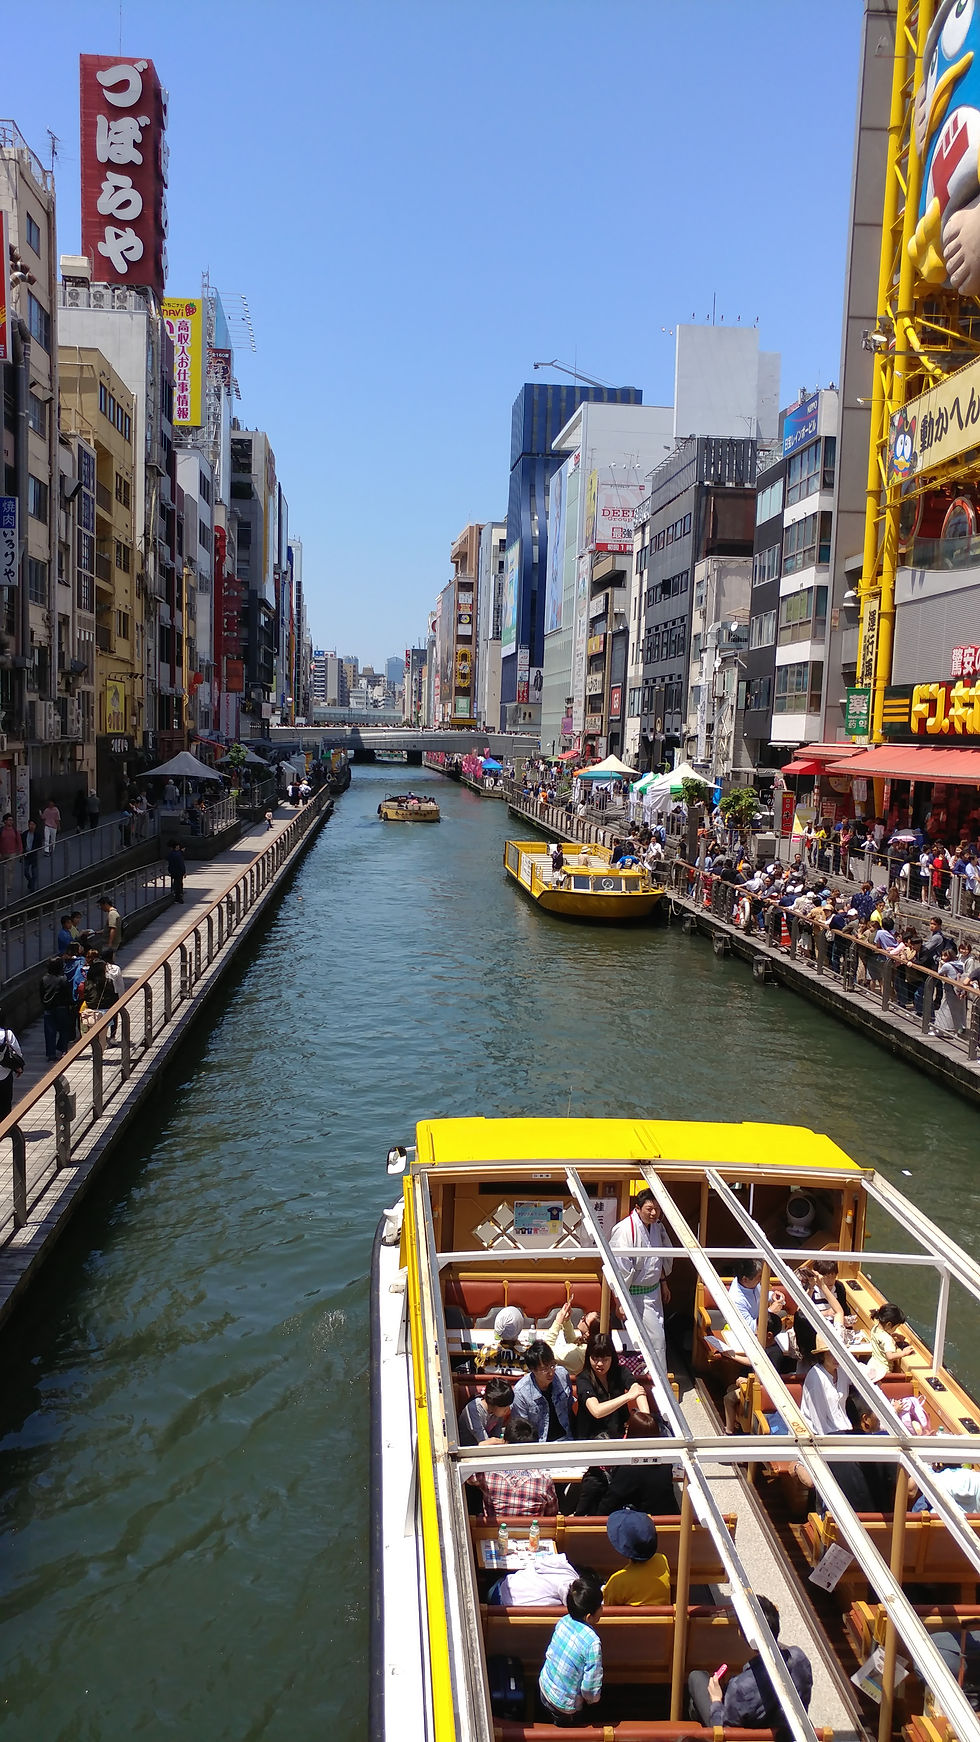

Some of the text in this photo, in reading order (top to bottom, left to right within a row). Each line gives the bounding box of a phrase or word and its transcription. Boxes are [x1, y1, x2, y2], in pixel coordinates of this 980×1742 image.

[96, 59, 151, 275] づぼらや
[177, 319, 190, 420] 高収入お仕事情報
[2, 500, 16, 583] 焼肉 いろりや
[611, 527, 633, 539] 最強
[848, 694, 868, 714] 薬
